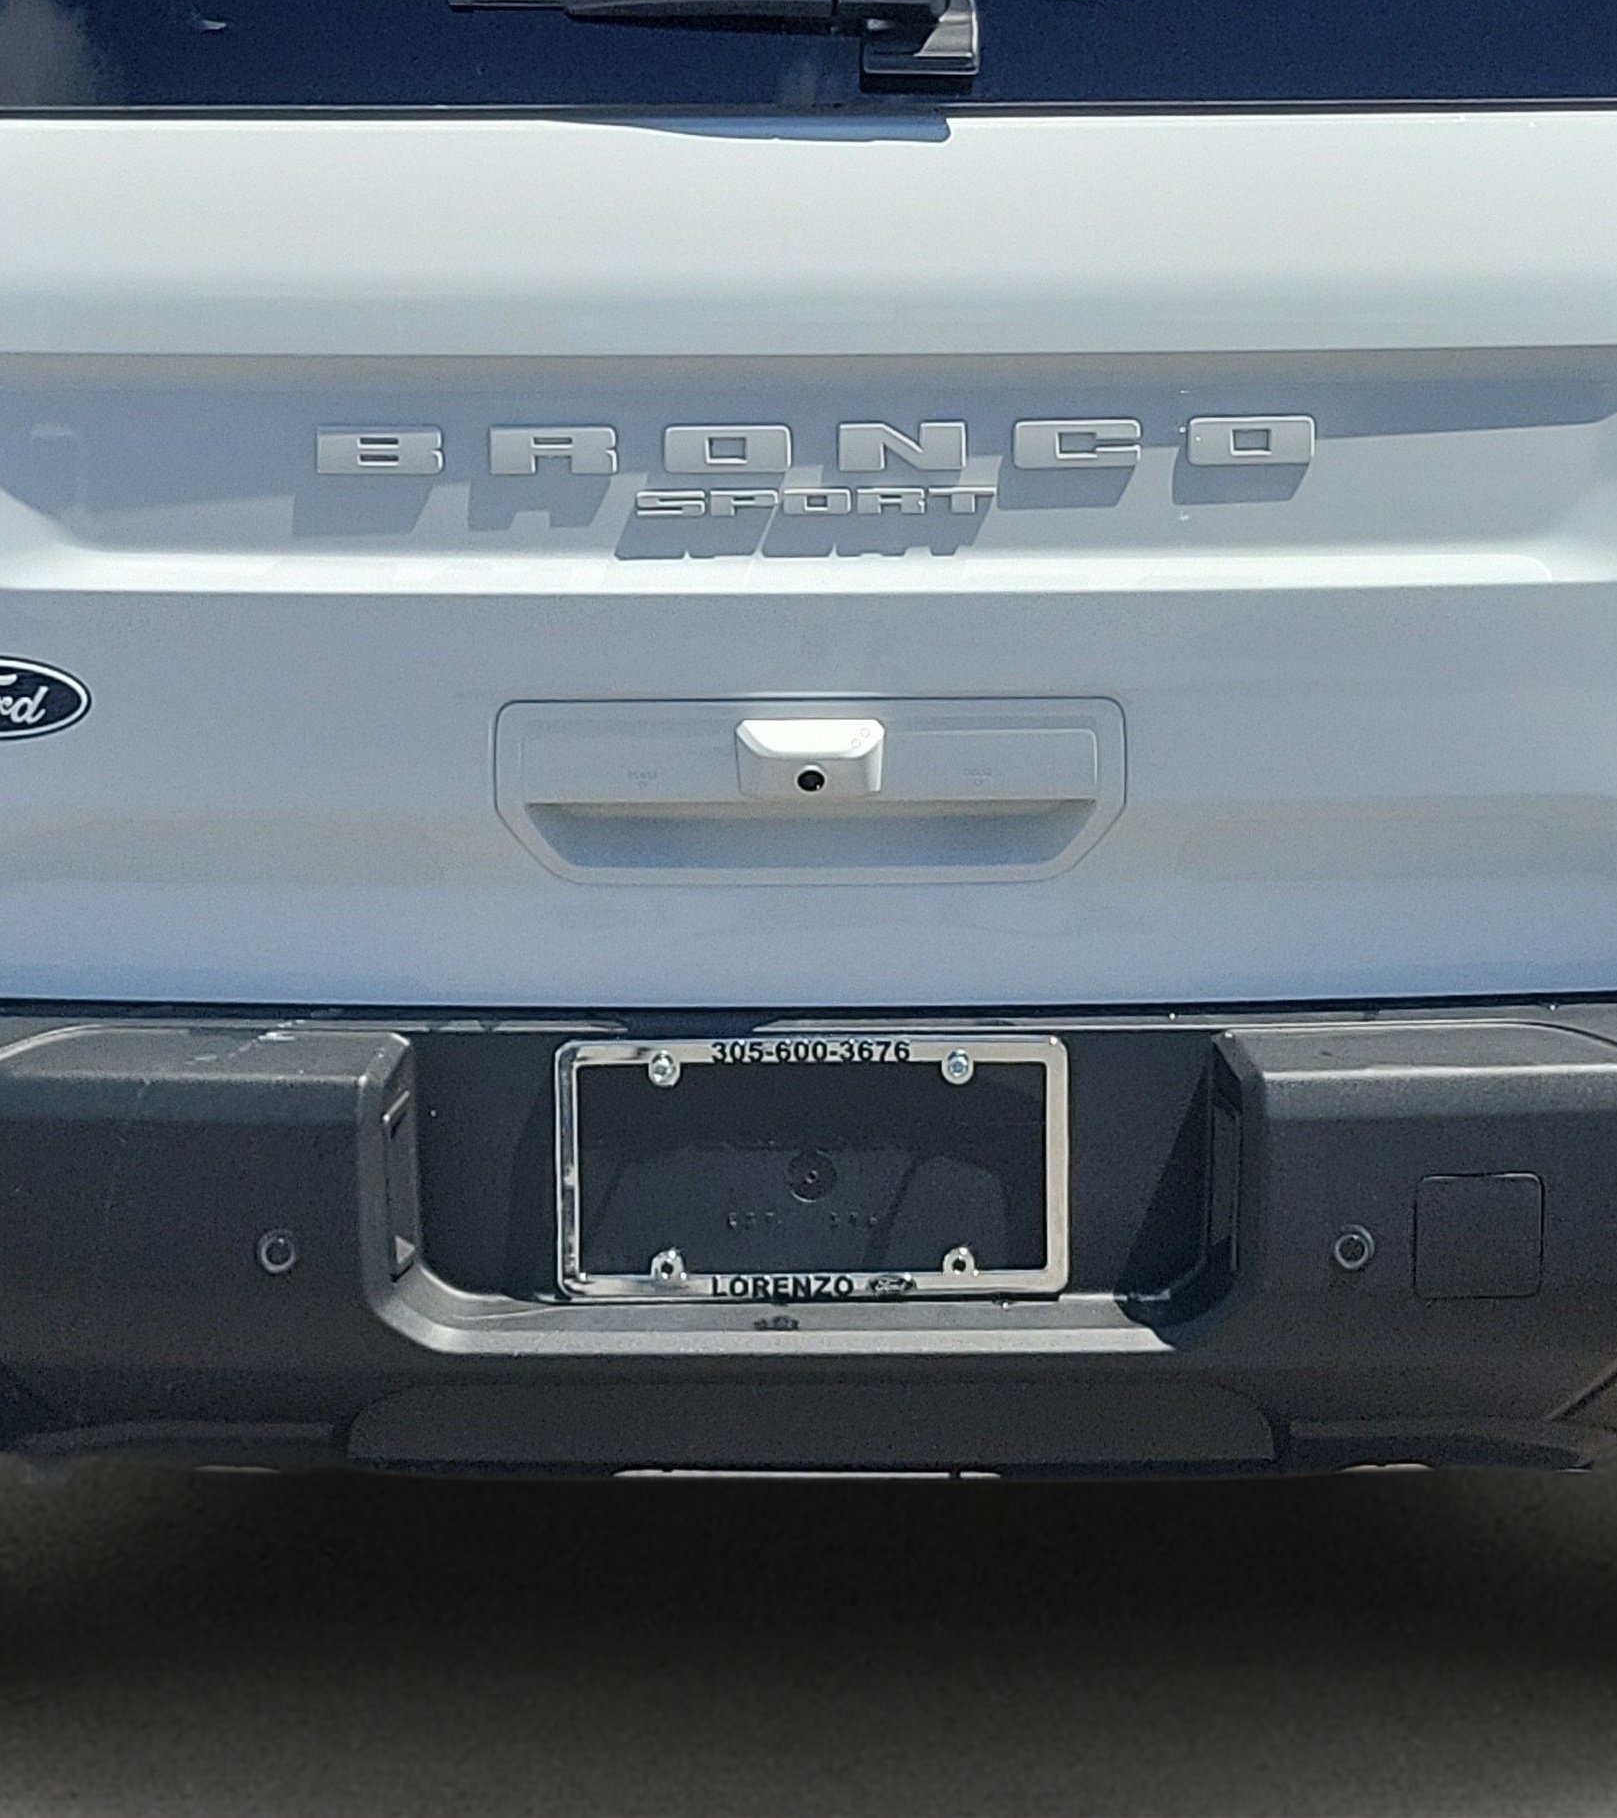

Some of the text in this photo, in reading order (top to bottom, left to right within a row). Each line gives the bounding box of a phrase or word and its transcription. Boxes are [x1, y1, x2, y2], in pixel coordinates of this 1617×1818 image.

[315, 415, 1316, 476] BRONCO
[636, 486, 997, 518] SPORT
[711, 1039, 911, 1063] 305-600-3676
[711, 1274, 854, 1299] LORENZO
